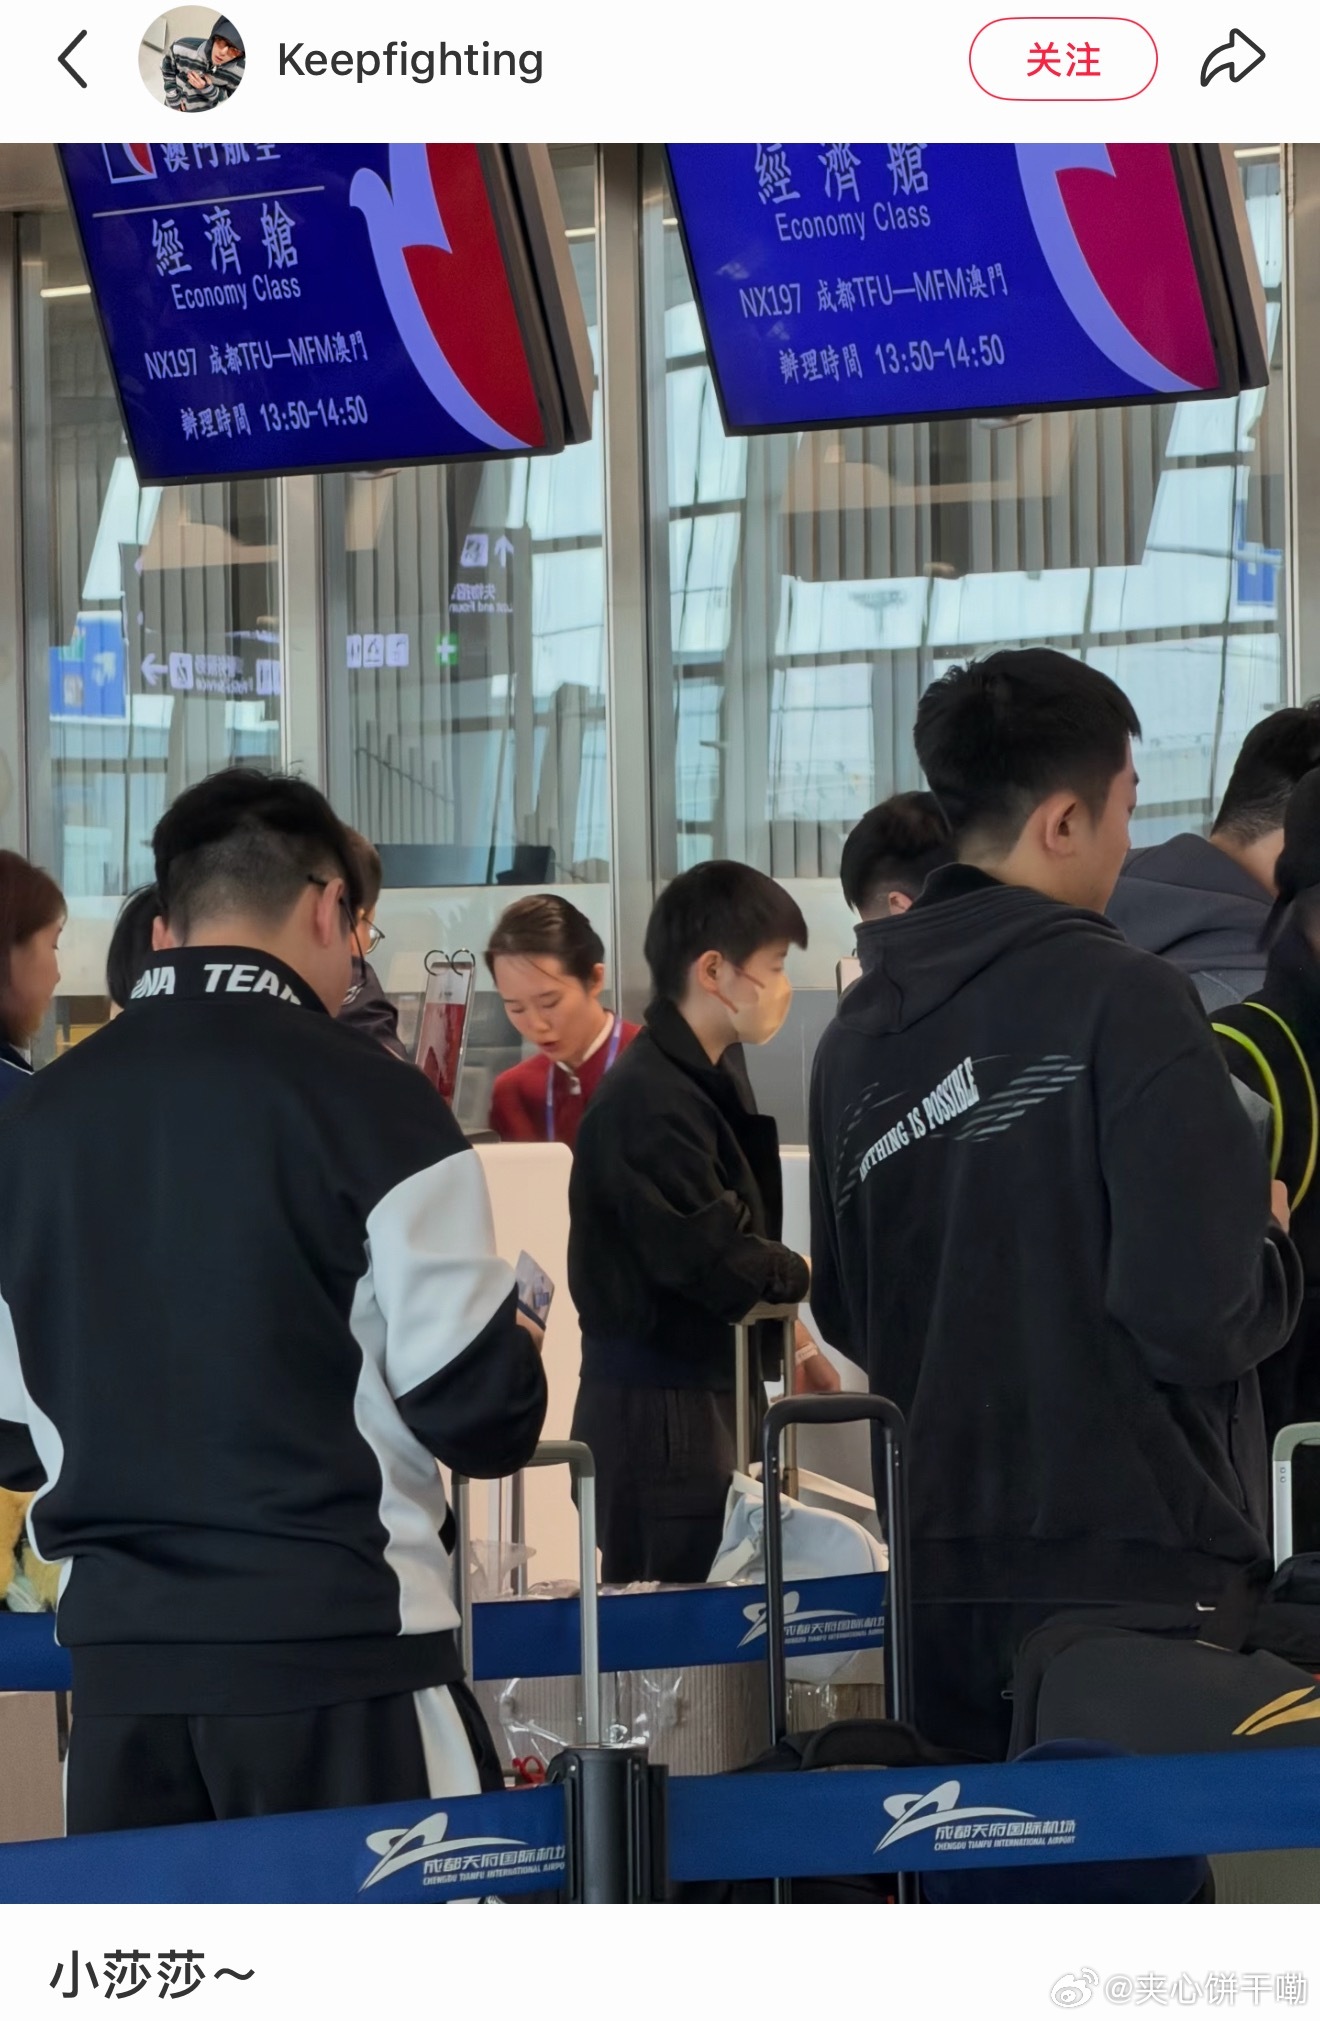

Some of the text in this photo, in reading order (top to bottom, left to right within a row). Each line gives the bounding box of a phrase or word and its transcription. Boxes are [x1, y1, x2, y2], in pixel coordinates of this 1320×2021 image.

[755, 143, 928, 204] 經濟艙
[152, 200, 299, 277] 經濟艙
[775, 201, 931, 242] Economy Class
[171, 274, 302, 310] Economy Class
[739, 283, 802, 318] NX197
[144, 348, 198, 380] NX197
[779, 334, 1006, 385] 辦理時間 13:50-14:50
[180, 395, 369, 441] 辦理時間 13:50-14:50
[906, 1107, 927, 1139] IS
[922, 1056, 980, 1130] POSSIBLE
[934, 1819, 1076, 1840] 成都天府国际机场
[934, 1835, 1076, 1851] CHENGDU TIANFU INTERNATIONAL AIRPORT
[423, 1861, 566, 1886] CHENGDU TIANFU INTERNATIONAL AIRPO
